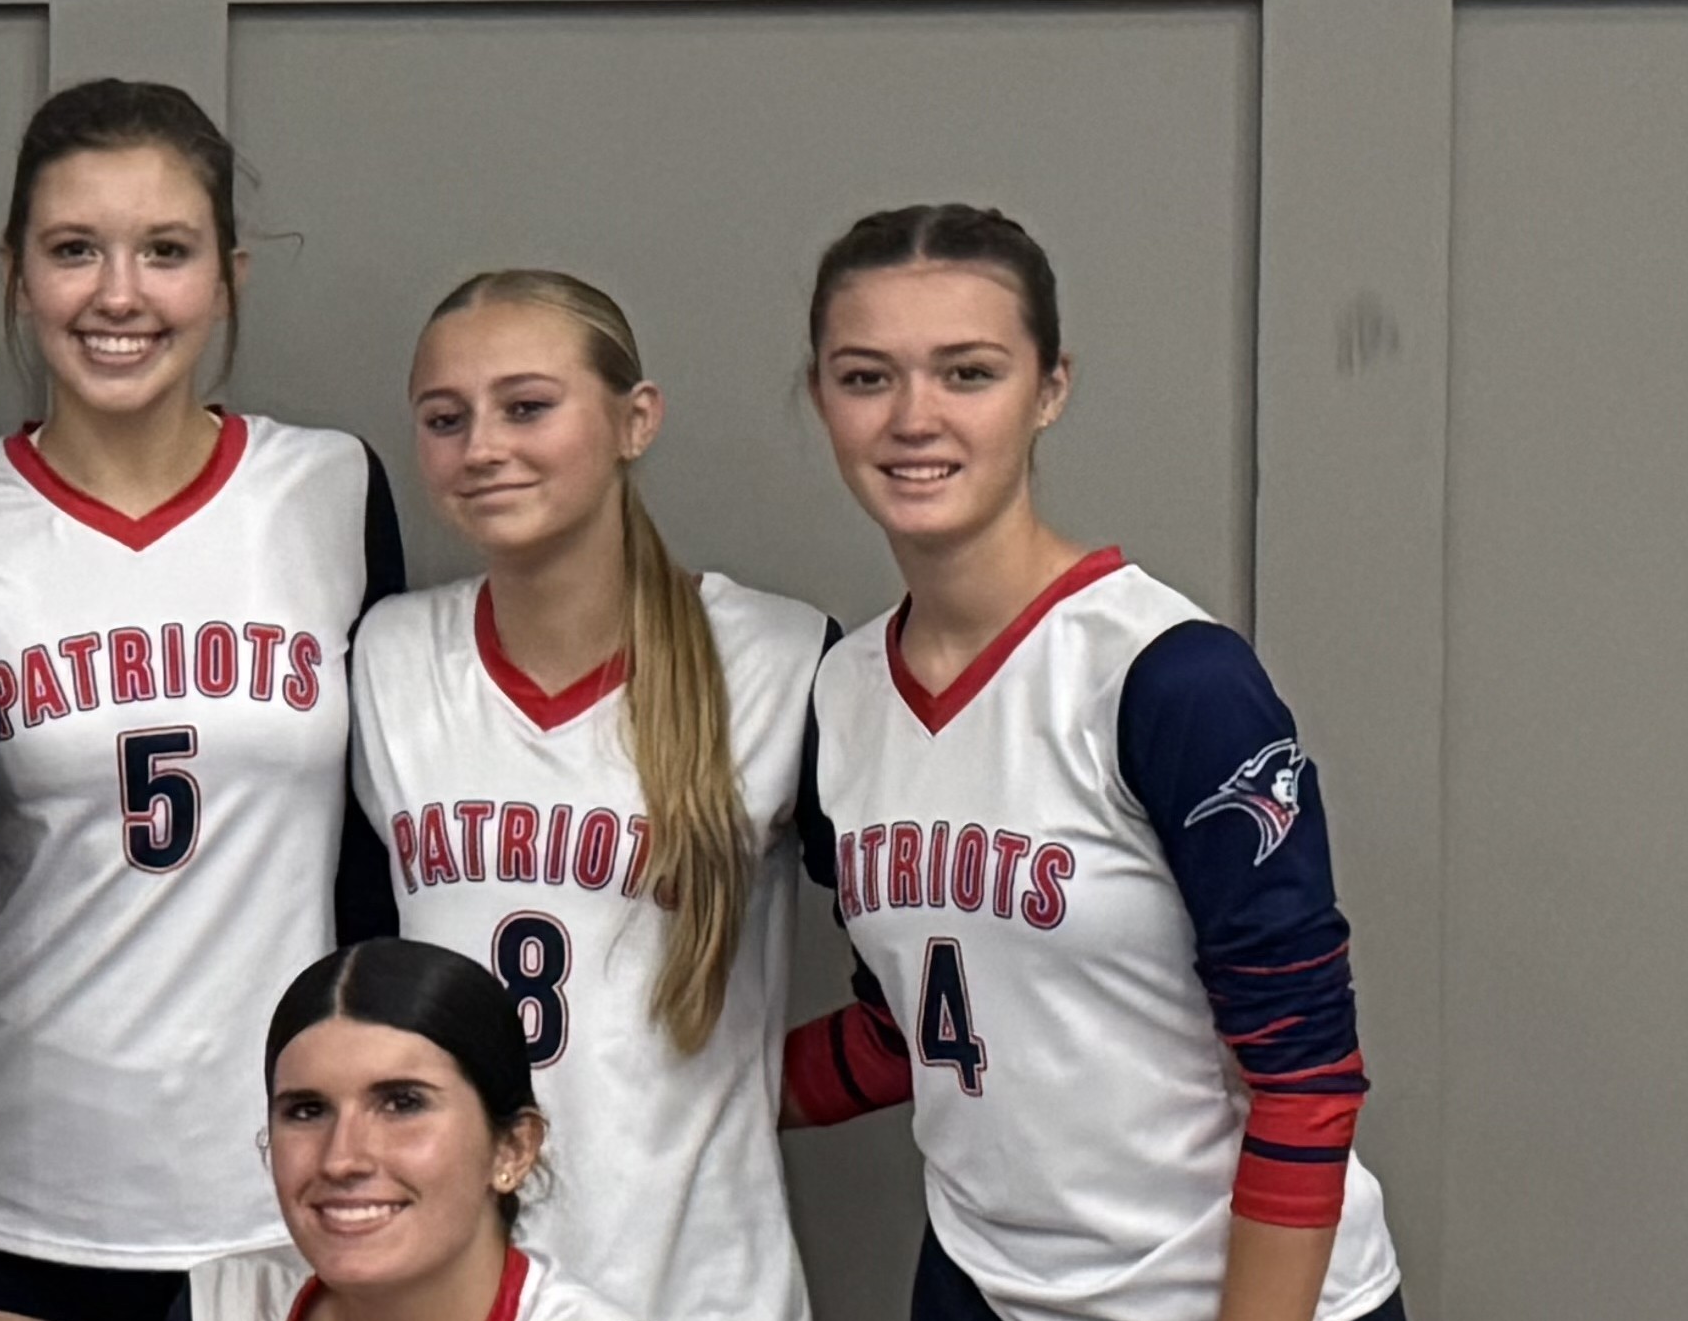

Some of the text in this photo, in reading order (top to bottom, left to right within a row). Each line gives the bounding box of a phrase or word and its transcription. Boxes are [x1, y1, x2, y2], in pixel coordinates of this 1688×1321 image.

[116, 724, 202, 874] 5
[392, 799, 679, 912] PATRIOT
[838, 820, 1075, 930] ATRIOTS
[491, 909, 572, 1070] 8
[916, 936, 987, 1098] 4
